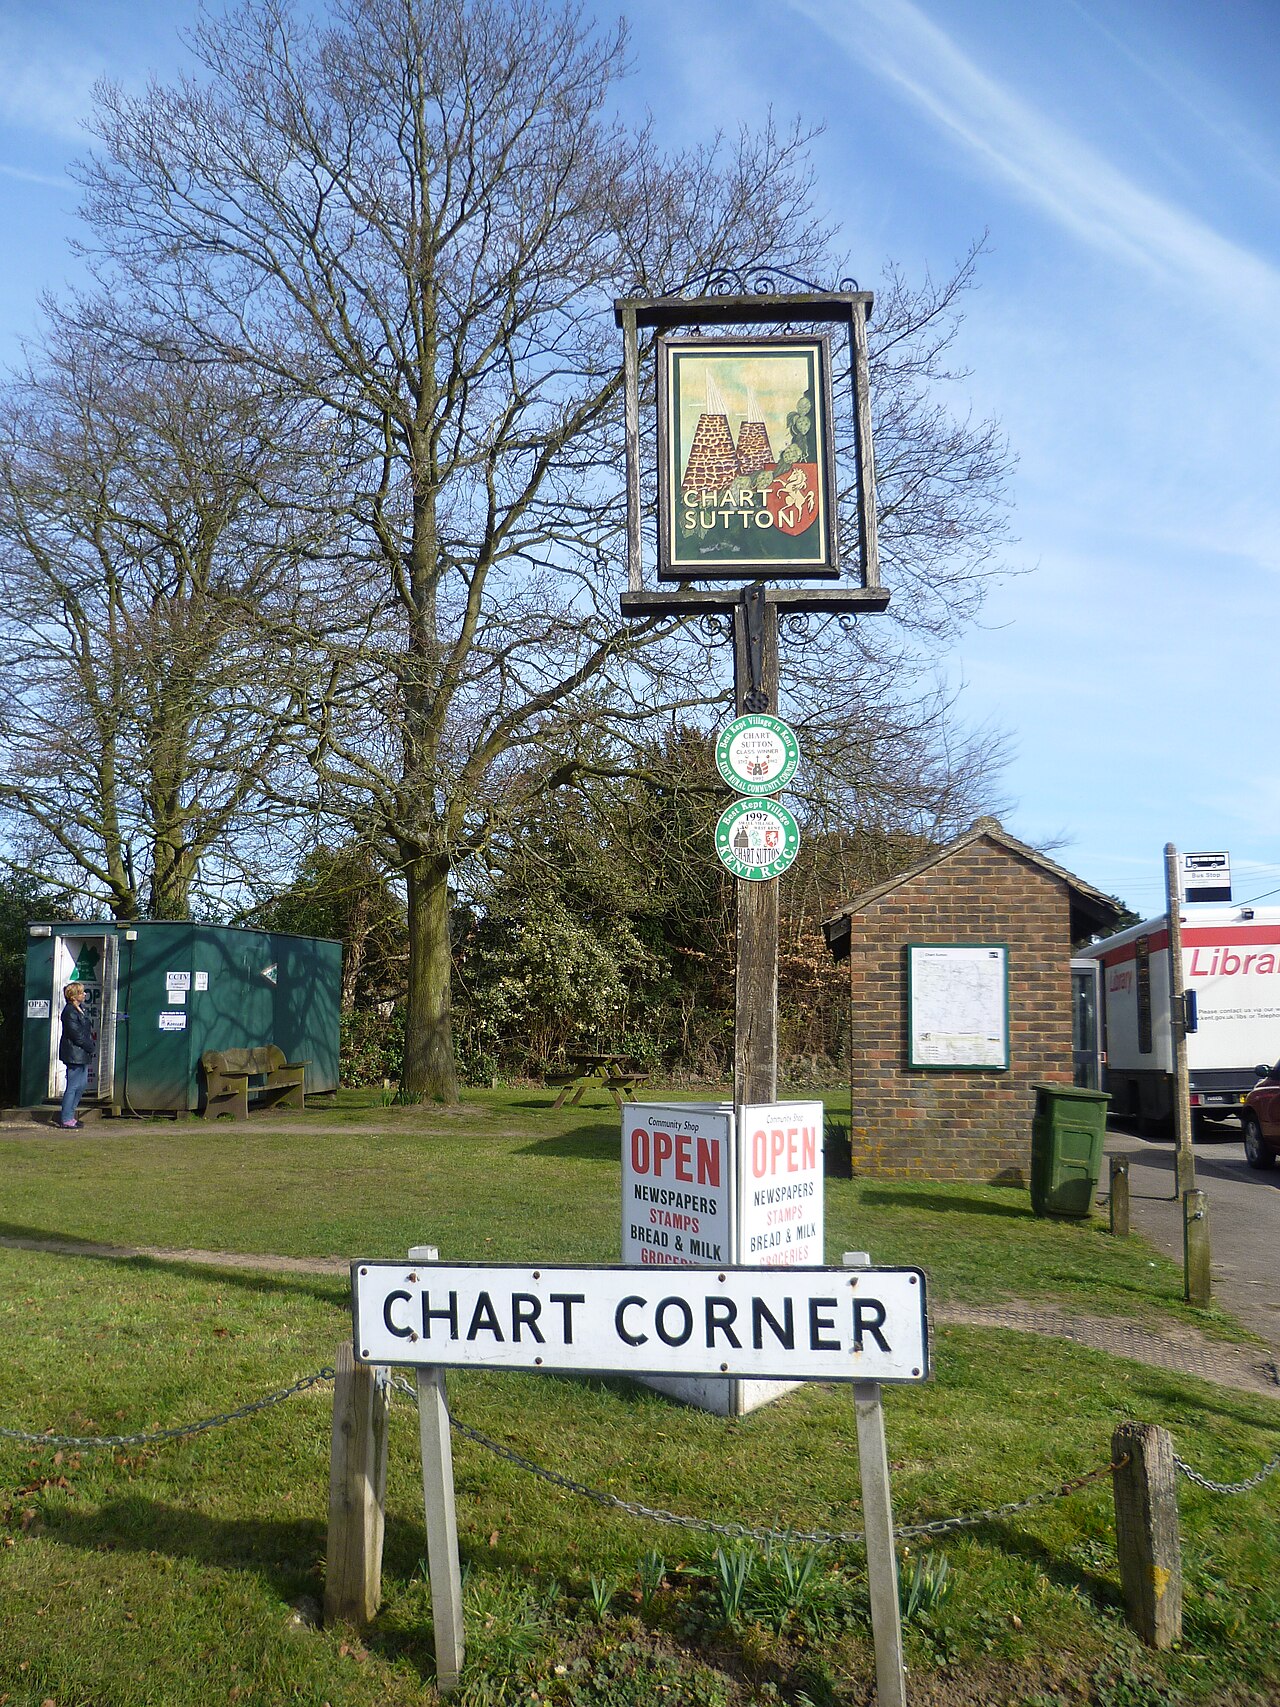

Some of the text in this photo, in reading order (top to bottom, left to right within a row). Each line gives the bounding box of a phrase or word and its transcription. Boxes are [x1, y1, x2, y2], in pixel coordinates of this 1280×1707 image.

[683, 489, 773, 508] CHART
[684, 510, 794, 529] SUTTON
[720, 716, 793, 748] Best Kept Village in Kent
[741, 740, 773, 748] SUTTON
[719, 760, 796, 793] KENT RURAL COMMUNITY COUNCIL
[722, 801, 790, 826] Best Kept Village
[746, 812, 768, 821] 1997
[719, 844, 796, 878] KENT R.C.C.
[734, 848, 780, 864] CHART SUTTON
[1189, 948, 1280, 976] Libra
[1109, 970, 1132, 994] Library
[648, 1116, 700, 1134] Community Shop
[766, 1113, 804, 1124] Community Shop
[631, 1128, 720, 1187] OPEN
[752, 1126, 816, 1178] OPEN
[634, 1184, 717, 1216] NEWSPAPERS
[754, 1181, 814, 1206] NEWSPAPERS
[649, 1207, 700, 1234] STAMPS
[766, 1204, 803, 1226] STAMPS
[630, 1224, 721, 1261] BREAD & MILK
[750, 1222, 816, 1253] BREAD & MILK
[759, 1245, 809, 1264] GROCERIES
[382, 1288, 892, 1352] CHART CORNER
